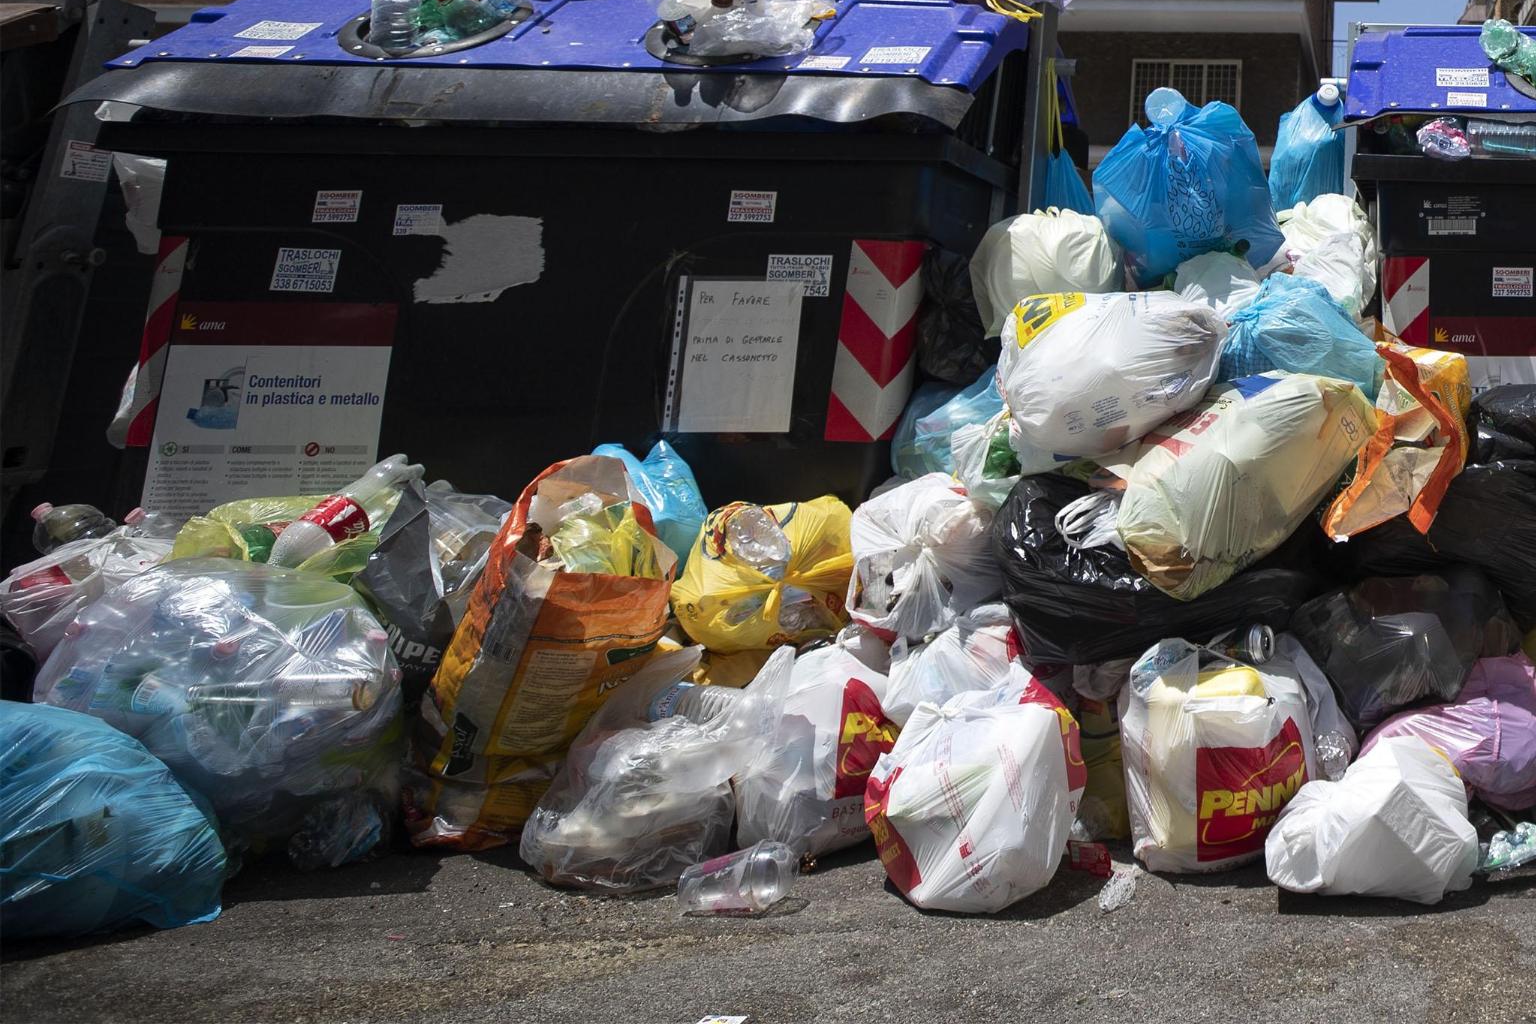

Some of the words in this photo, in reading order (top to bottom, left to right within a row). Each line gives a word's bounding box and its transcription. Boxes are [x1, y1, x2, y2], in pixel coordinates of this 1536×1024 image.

[733, 192, 774, 200] SGOMBERI
[743, 213, 771, 221] 5992753
[281, 248, 339, 262] TRASLOCHI
[769, 256, 830, 266] TRASLOCHI
[277, 261, 321, 273] SGOMBERI
[768, 270, 816, 279] SGOMBERI
[273, 278, 291, 289] 338
[292, 279, 332, 291] 6715053
[803, 285, 828, 296] 7542
[700, 291, 714, 304] PER
[732, 291, 770, 305] FAVORE
[199, 321, 225, 330] ama
[692, 335, 718, 344] PRIMA
[725, 336, 734, 344] DI
[1451, 333, 1475, 343] ama
[690, 353, 709, 363] NEL
[249, 374, 321, 389] Contenitori
[246, 391, 258, 405] in
[262, 391, 314, 408] plastica
[318, 394, 326, 406] e
[330, 391, 380, 407] metallo
[231, 446, 252, 454] COME
[324, 446, 335, 454] NO
[386, 623, 441, 664] NIPE
[1200, 762, 1305, 819] PENNY
